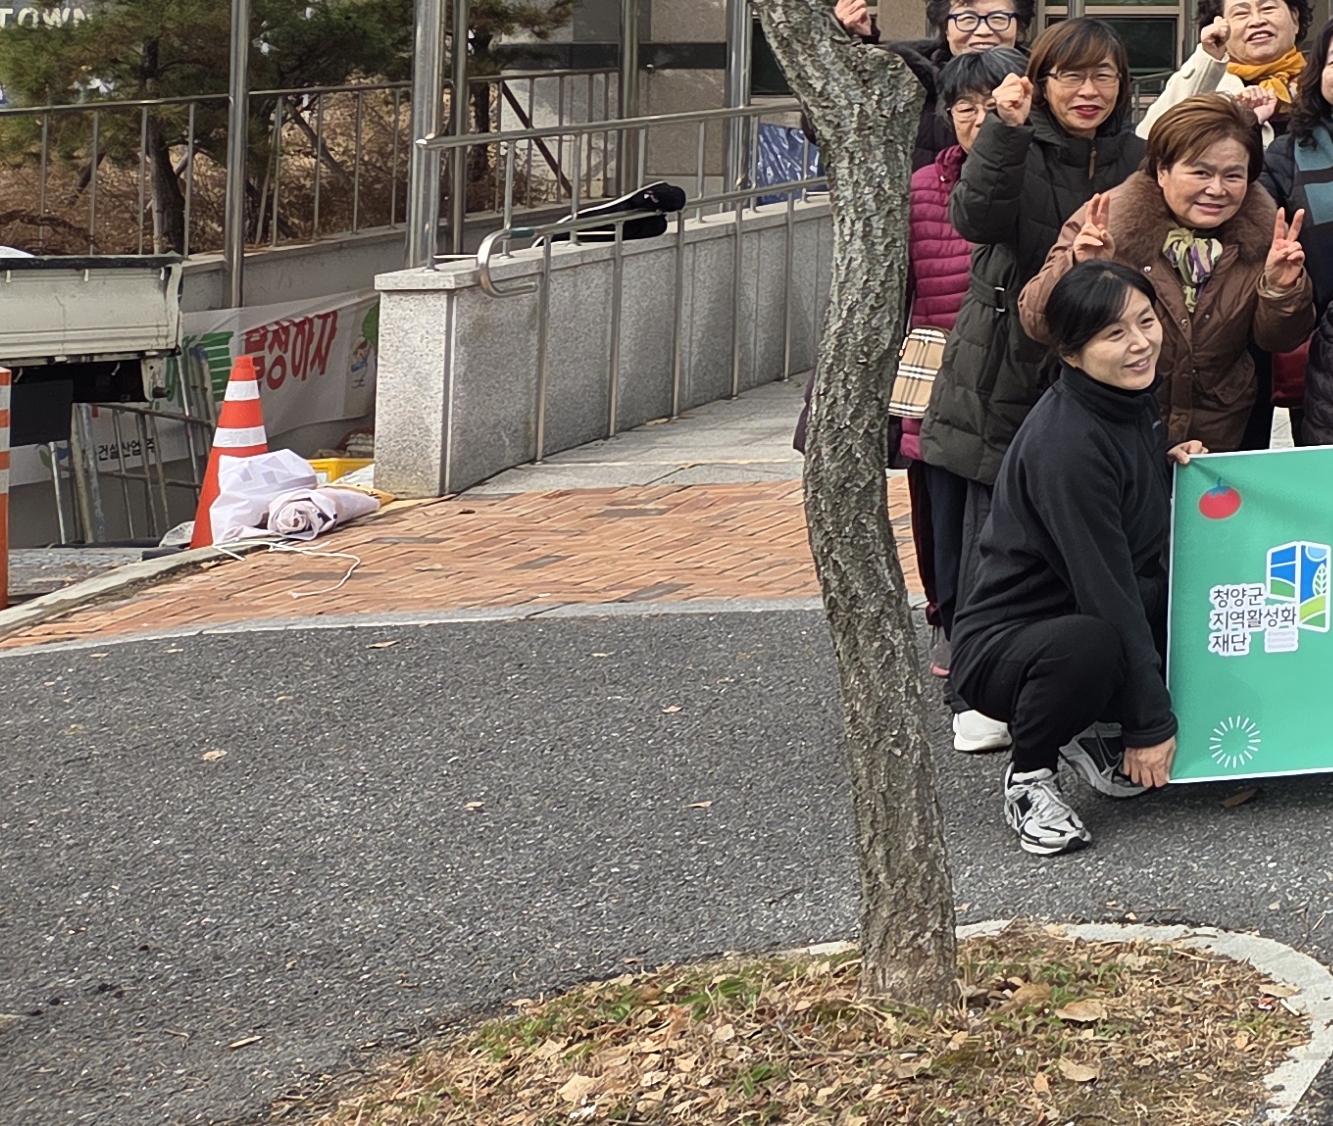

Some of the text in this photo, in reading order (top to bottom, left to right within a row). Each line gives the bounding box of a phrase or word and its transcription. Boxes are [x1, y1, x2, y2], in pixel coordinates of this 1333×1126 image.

[1213, 587, 1263, 608] 청양군
[1212, 606, 1297, 630] 지역활성화
[1212, 632, 1247, 653] 재단
